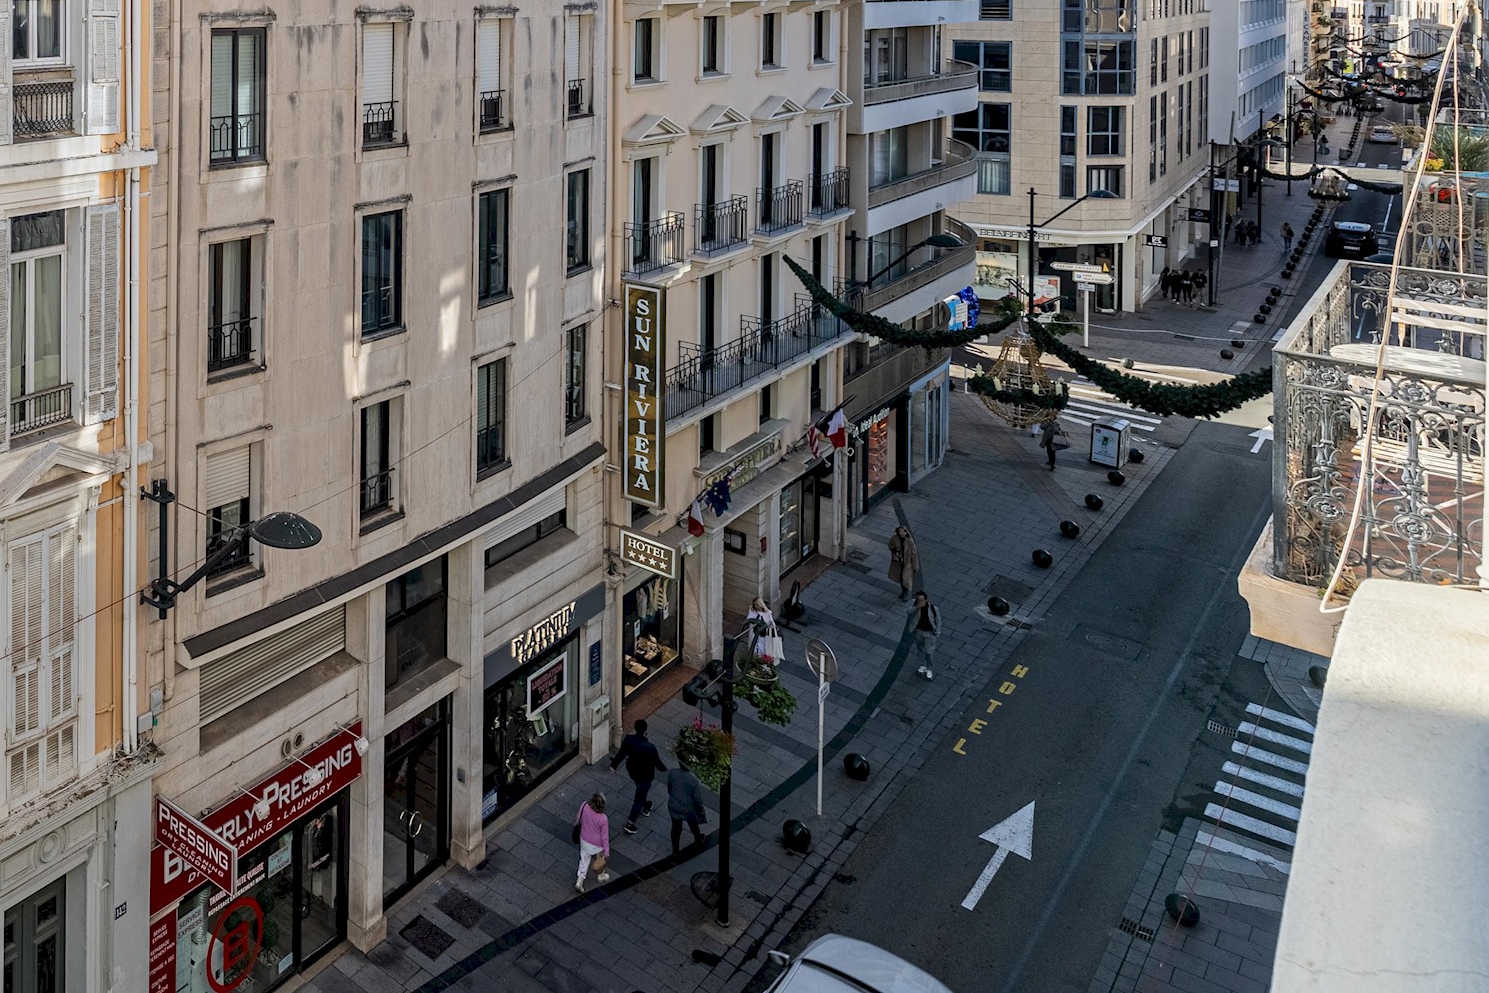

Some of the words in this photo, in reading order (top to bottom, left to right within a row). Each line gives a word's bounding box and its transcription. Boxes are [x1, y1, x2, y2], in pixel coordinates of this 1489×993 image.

[635, 298, 651, 352] SUN
[634, 364, 651, 491] RIVIERA
[628, 538, 668, 560] HOTEL
[953, 664, 1029, 755] HOTEL
[283, 780, 333, 819] LAUNDRY
[159, 803, 229, 871] PRESSING
[161, 828, 178, 843] DRY
[180, 843, 224, 878] CLEANING
[171, 842, 213, 874] LAUNDRY
[178, 917, 203, 940] EXPRESS
[179, 908, 202, 929] SERVICE
